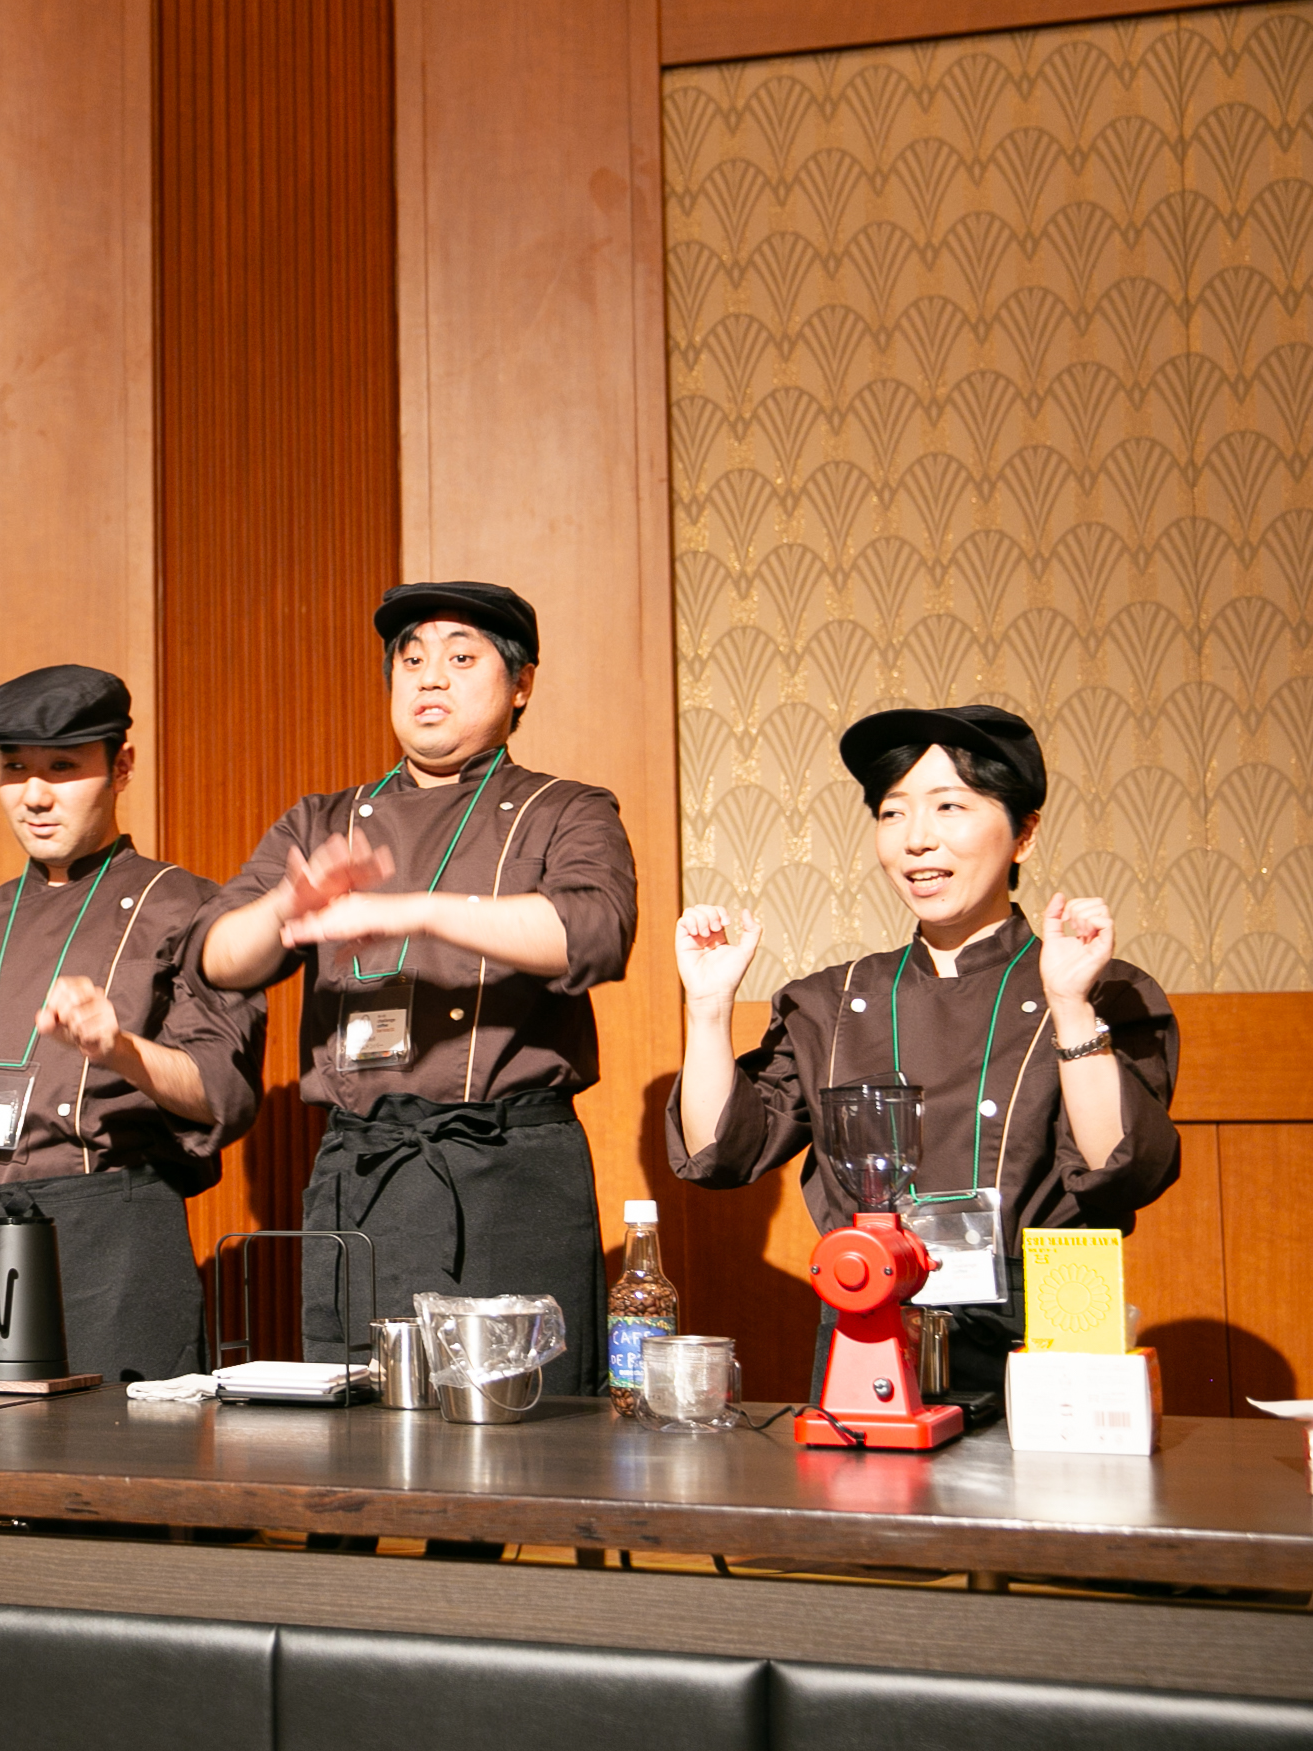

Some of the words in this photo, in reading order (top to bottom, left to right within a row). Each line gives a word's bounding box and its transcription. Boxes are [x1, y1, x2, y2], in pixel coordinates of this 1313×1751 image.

[1047, 1236, 1088, 1247] FILTER
[1089, 1236, 1119, 1247] WAVE
[610, 1353, 624, 1367] DE
